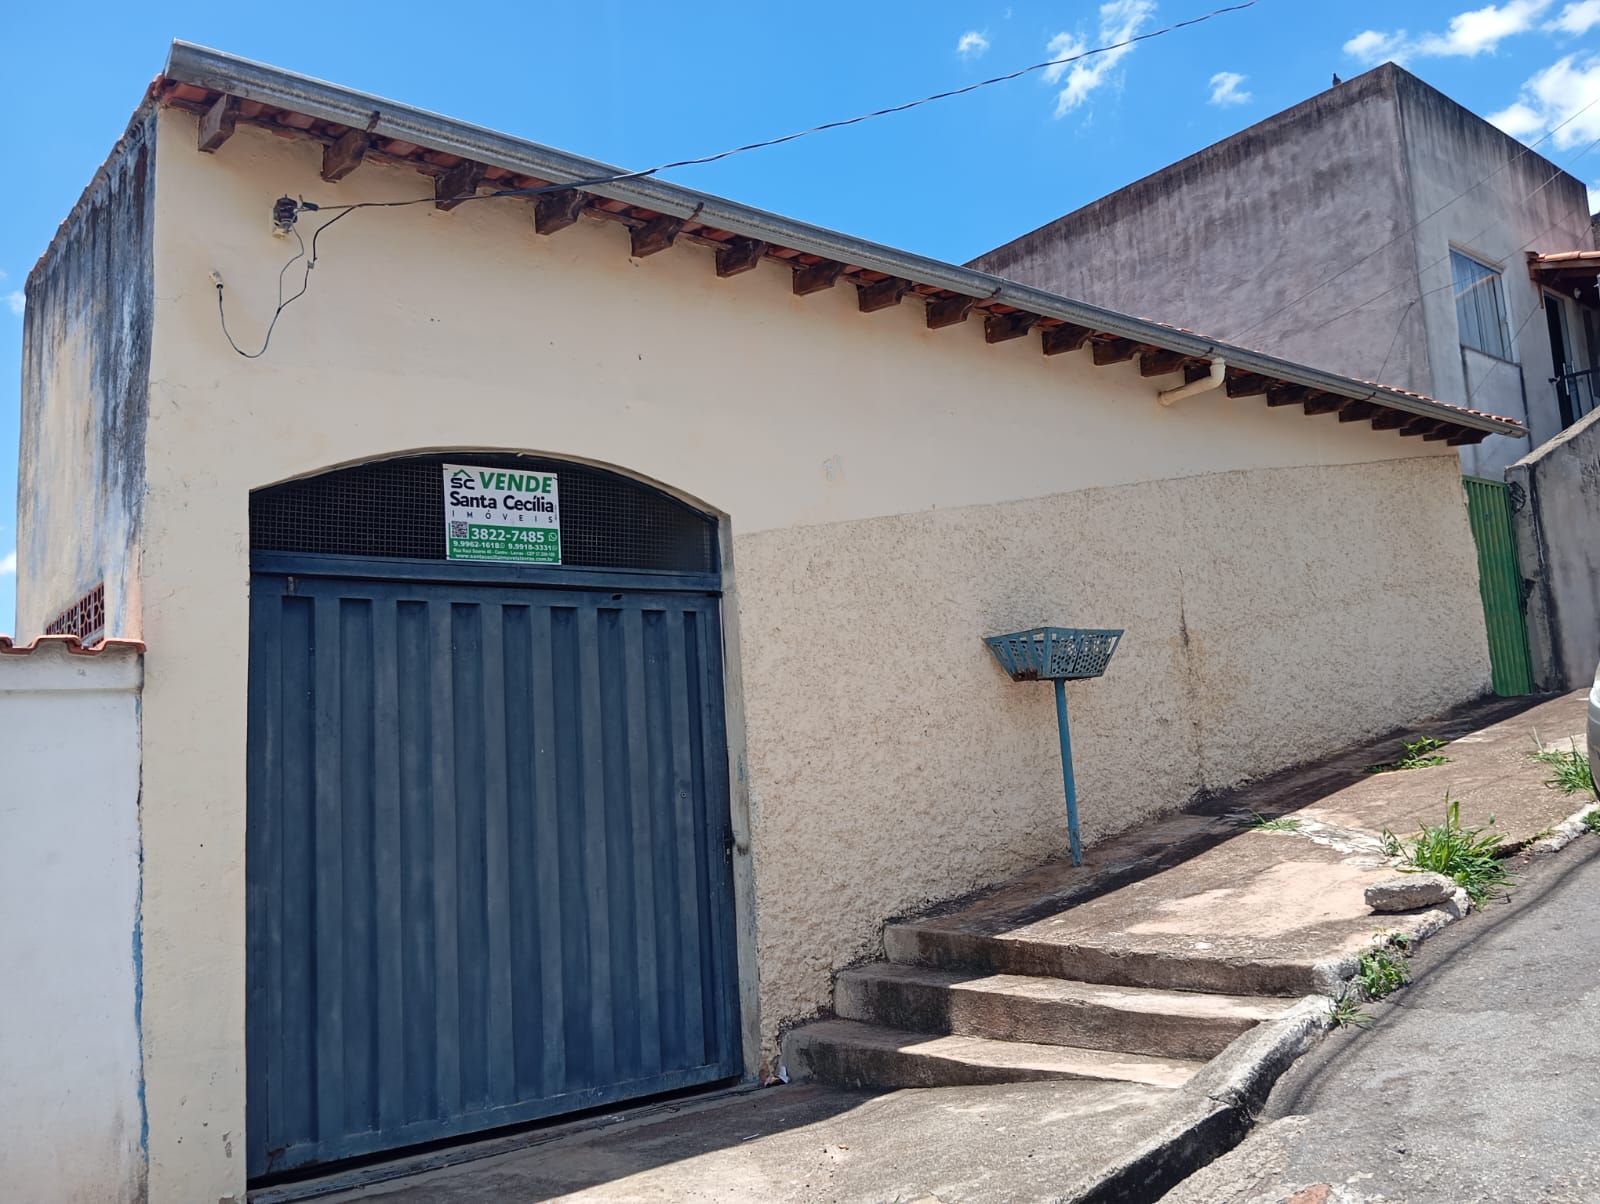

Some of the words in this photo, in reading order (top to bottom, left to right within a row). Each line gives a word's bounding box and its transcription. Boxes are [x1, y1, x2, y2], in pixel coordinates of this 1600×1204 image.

[450, 477, 475, 490] SC
[479, 471, 553, 494] VENDE
[450, 490, 497, 509] Santa
[503, 494, 554, 513] Cecília
[471, 528, 544, 543] 3822-7485
